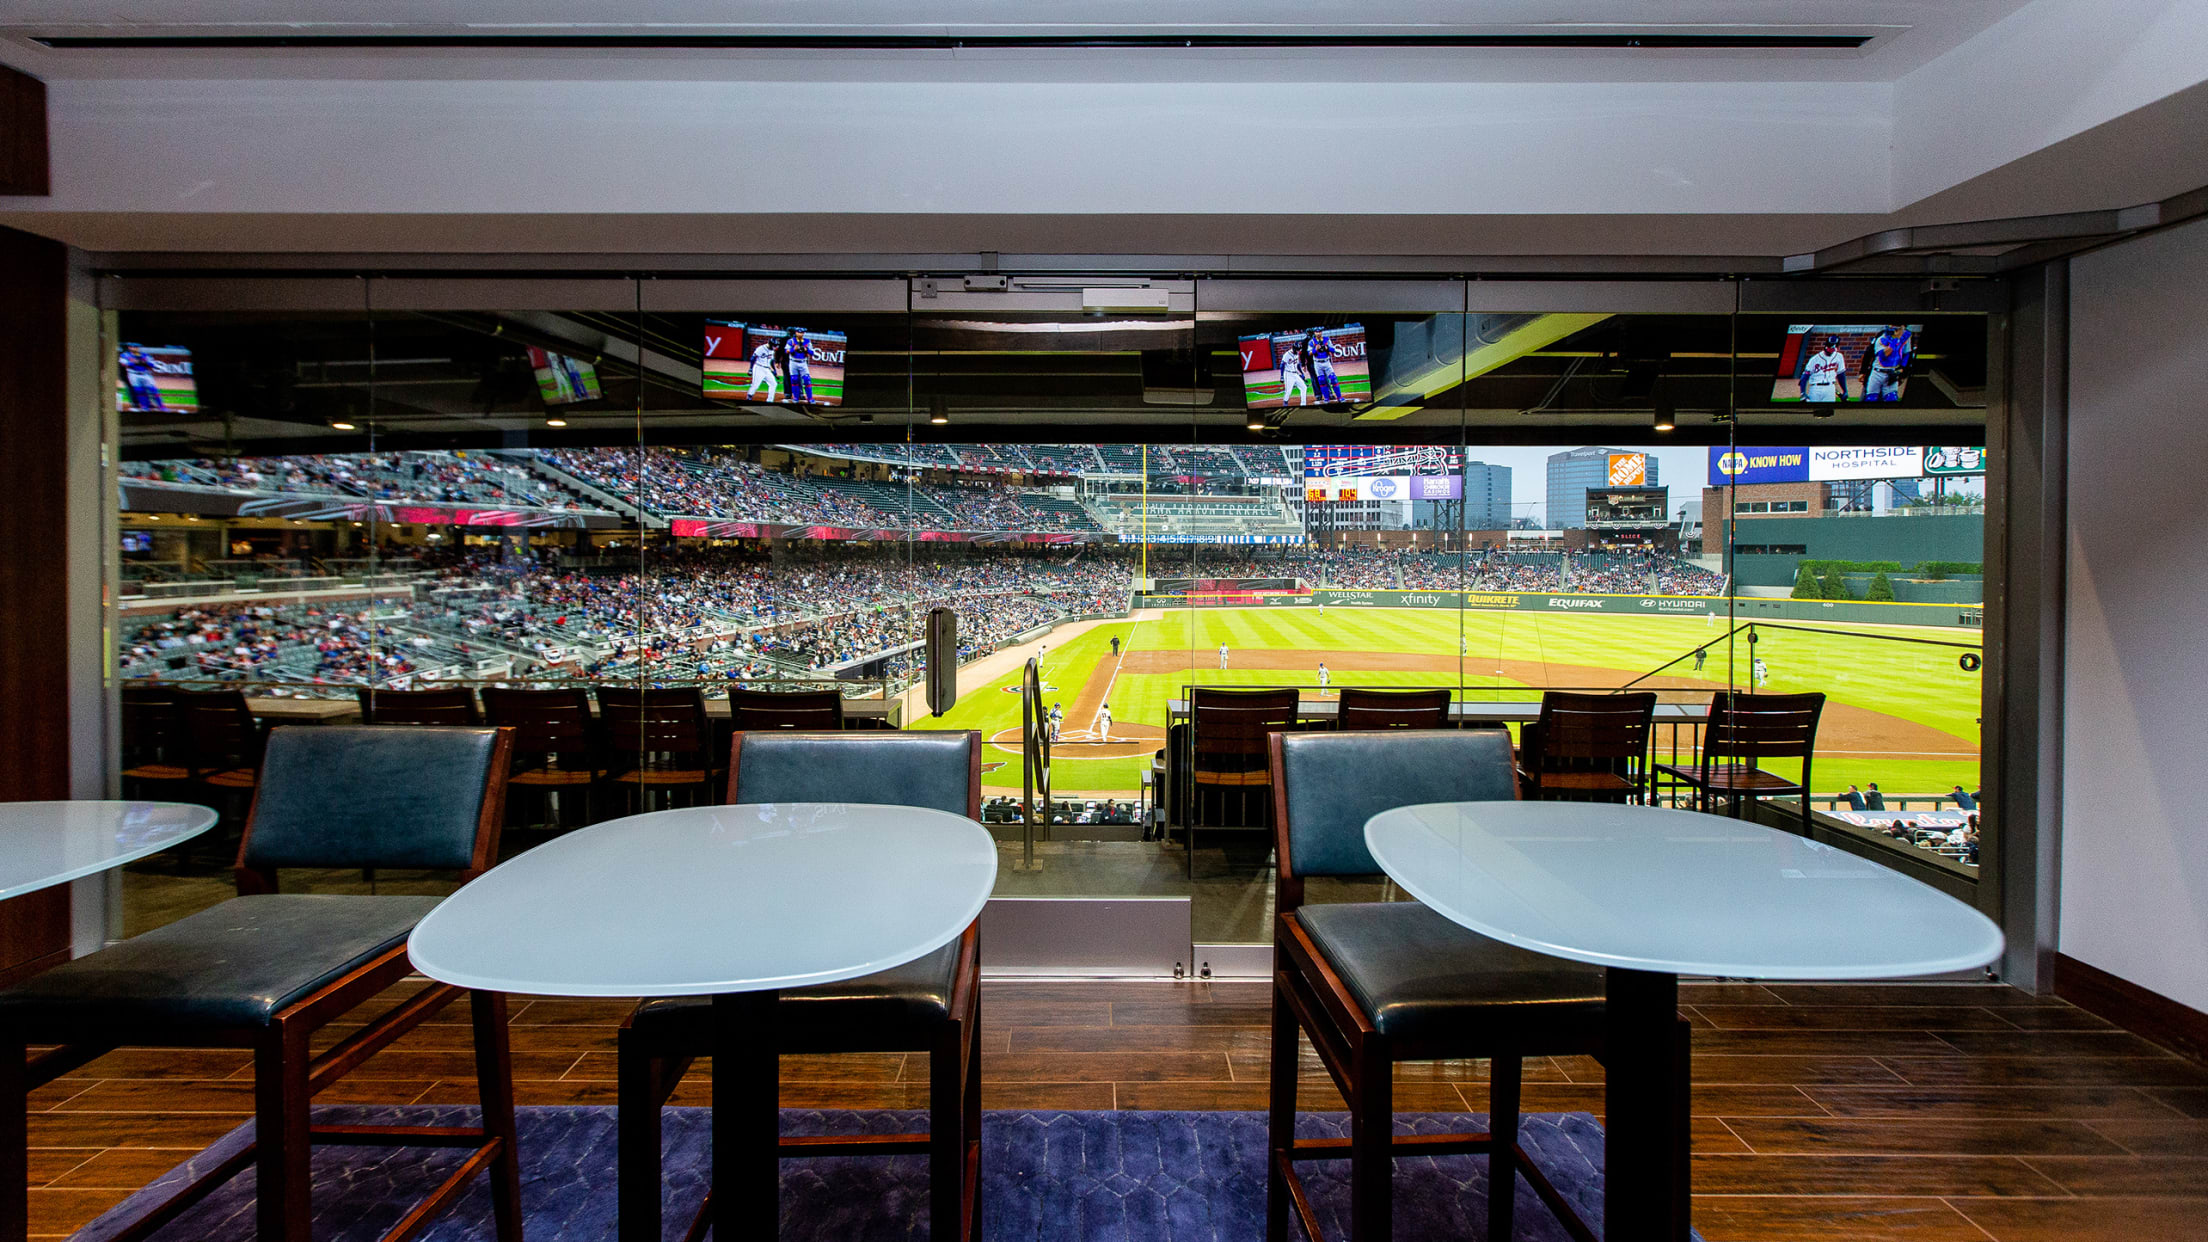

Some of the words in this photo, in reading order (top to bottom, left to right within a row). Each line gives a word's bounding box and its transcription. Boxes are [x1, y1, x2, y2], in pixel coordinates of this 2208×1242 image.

[1815, 447, 1917, 460] NORTHSIDE
[1749, 455, 1777, 468] KNOW
[1779, 454, 1802, 466] HOW
[1832, 459, 1897, 468] HOSPITAL
[1609, 453, 1645, 485] HOME
[1623, 466, 1644, 485] DEPOT
[1372, 480, 1396, 497] Kroger
[1328, 591, 1374, 600] WELLSTAR
[1400, 594, 1440, 606] xfinity
[1467, 594, 1520, 605] QUIKRETE
[1548, 598, 1603, 609] EQUIFAX
[1658, 600, 1706, 608] HYUNDAI
